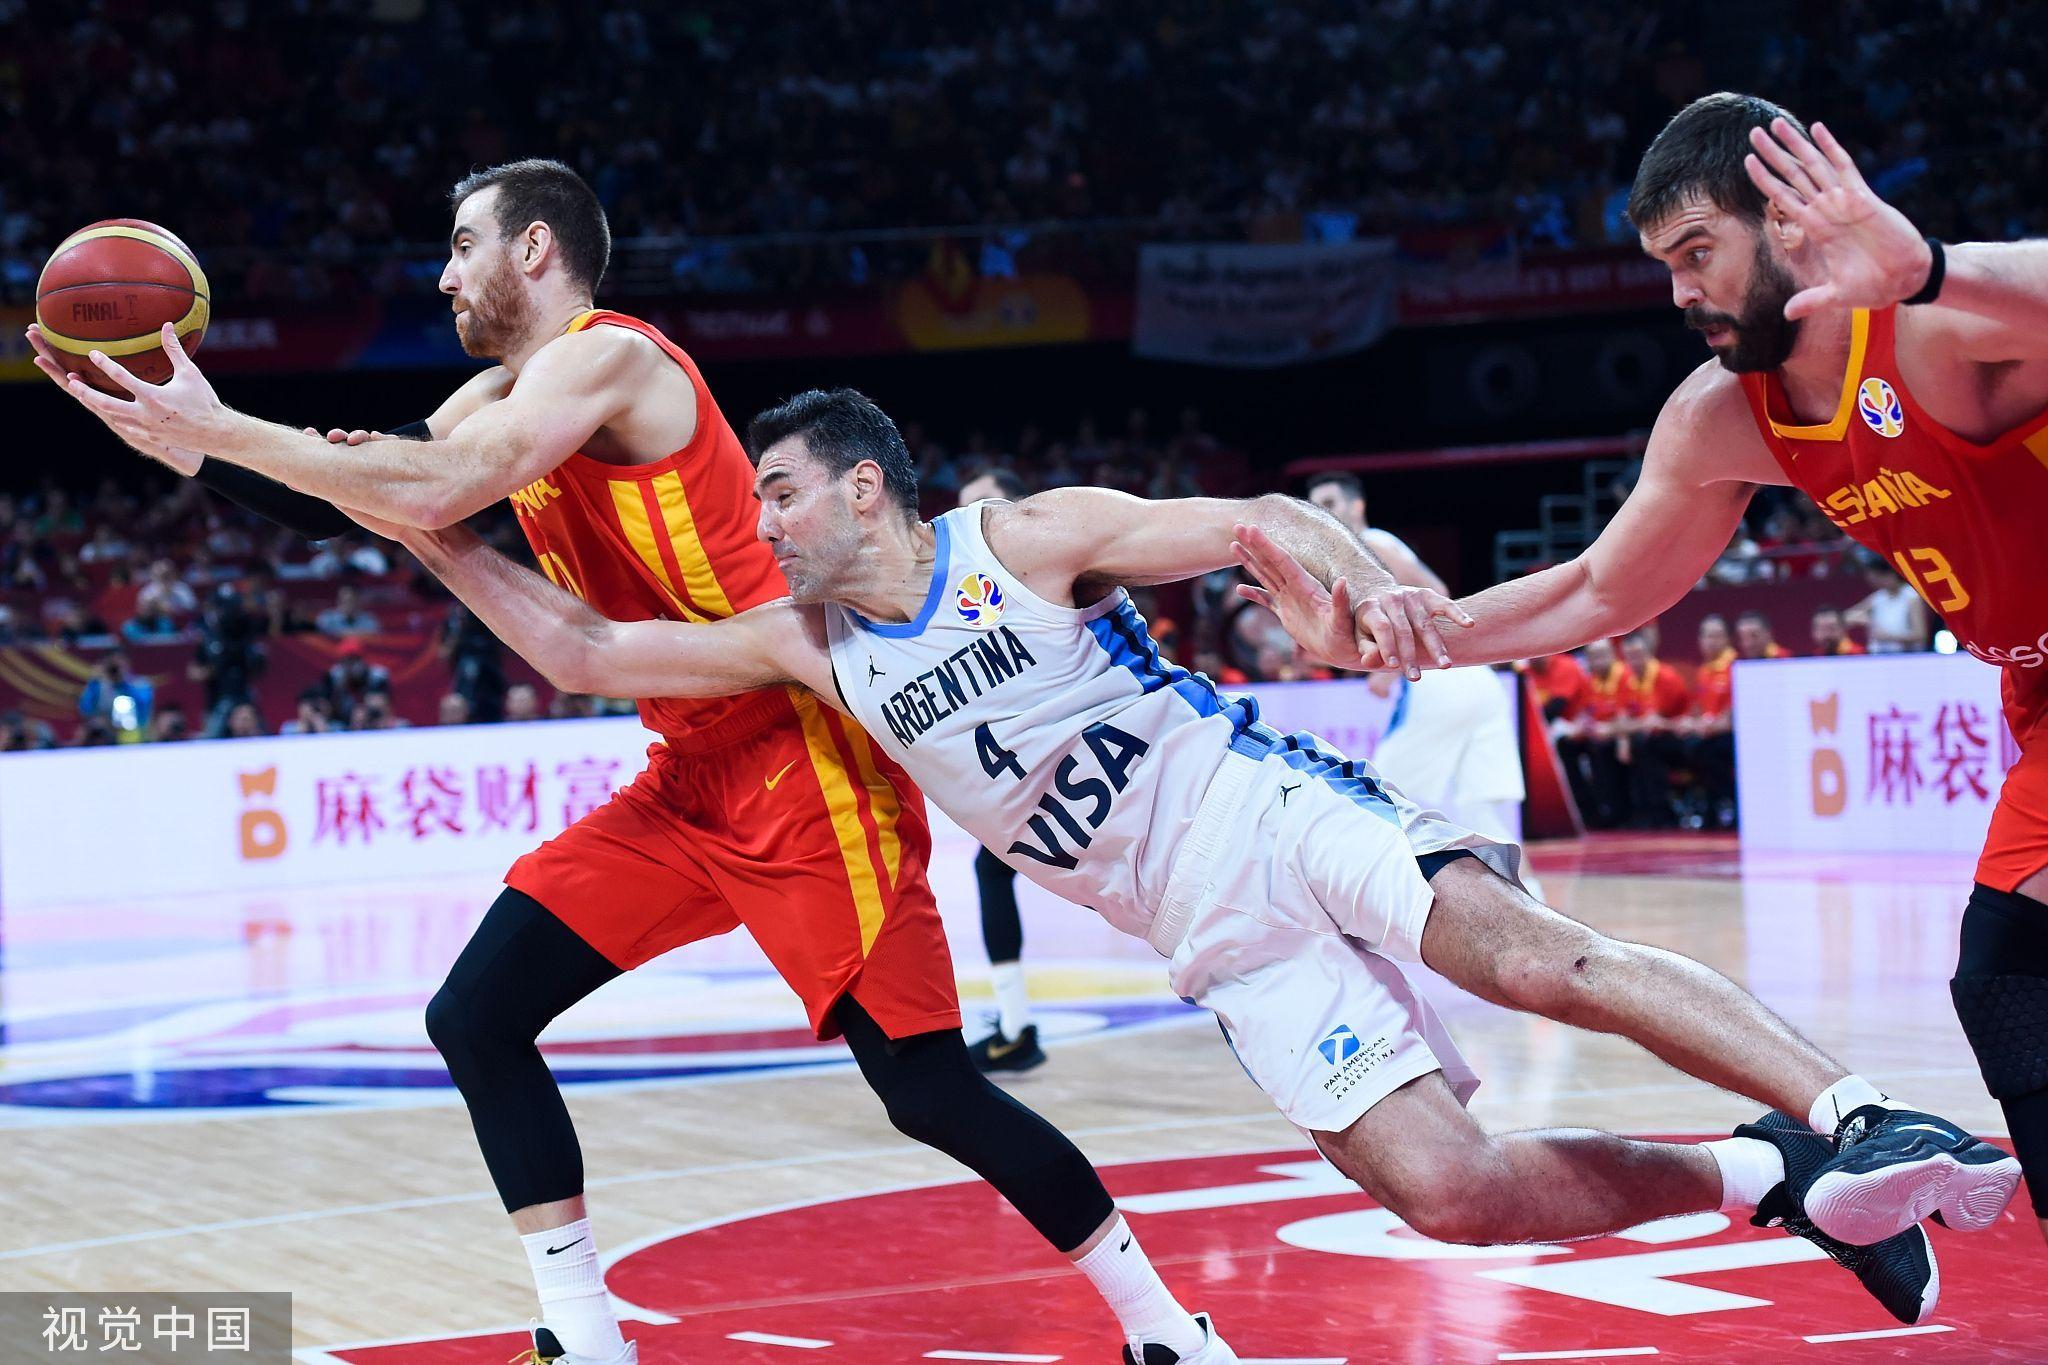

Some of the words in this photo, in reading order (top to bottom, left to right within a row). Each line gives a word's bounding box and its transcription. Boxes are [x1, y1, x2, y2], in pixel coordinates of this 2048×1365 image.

[72, 300, 123, 323] FINAL
[1893, 547, 1970, 613] 13
[880, 625, 1037, 749] ARGENTINA
[974, 721, 1027, 781] 4
[1007, 721, 1150, 871] VISA
[1323, 1072, 1342, 1091] PAN
[1343, 1037, 1386, 1073] AMERICAN
[1336, 1049, 1396, 1100] ARGENTINA
[1344, 1053, 1376, 1081] SILVER
